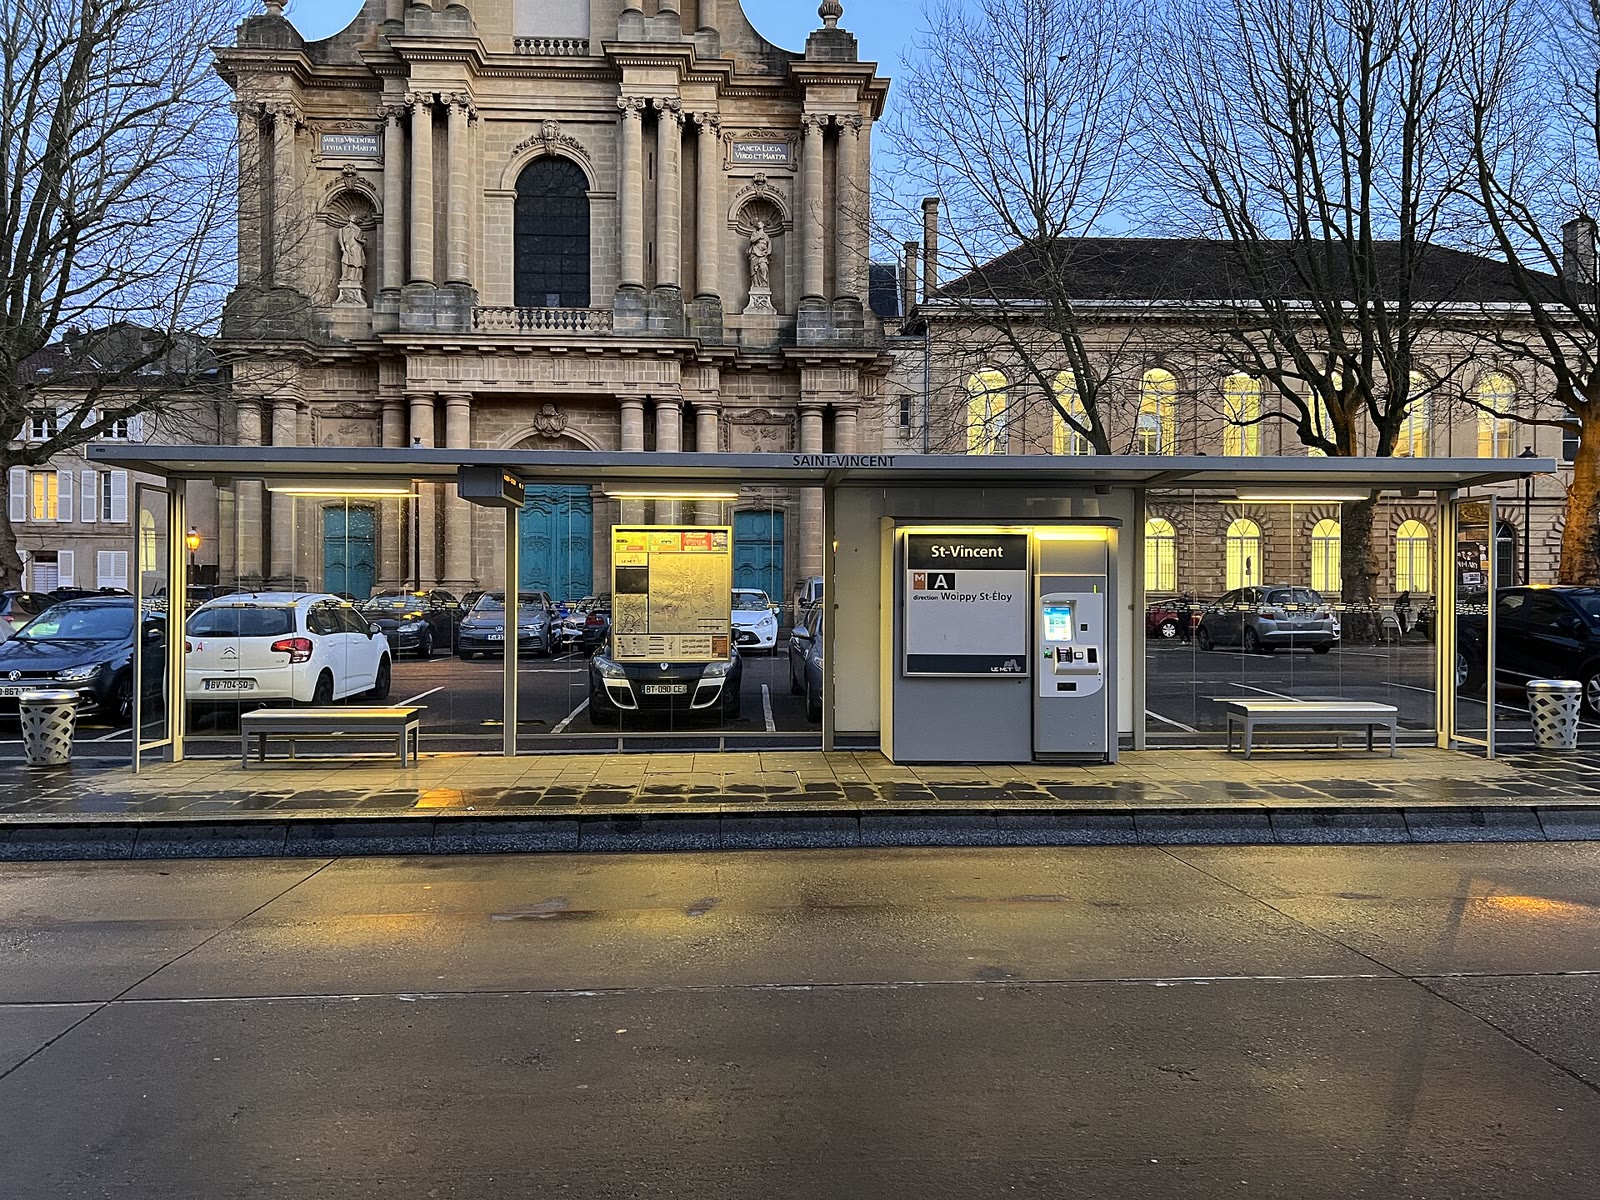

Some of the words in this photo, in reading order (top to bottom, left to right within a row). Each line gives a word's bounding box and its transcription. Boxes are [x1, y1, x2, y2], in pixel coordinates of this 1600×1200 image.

[792, 455, 896, 467] SAINT-VINCENT
[931, 545, 1004, 558] St-Vincent
[934, 574, 948, 589] A
[940, 592, 977, 602] Woippy
[979, 591, 1013, 603] St-Éloy
[196, 642, 204, 651] A
